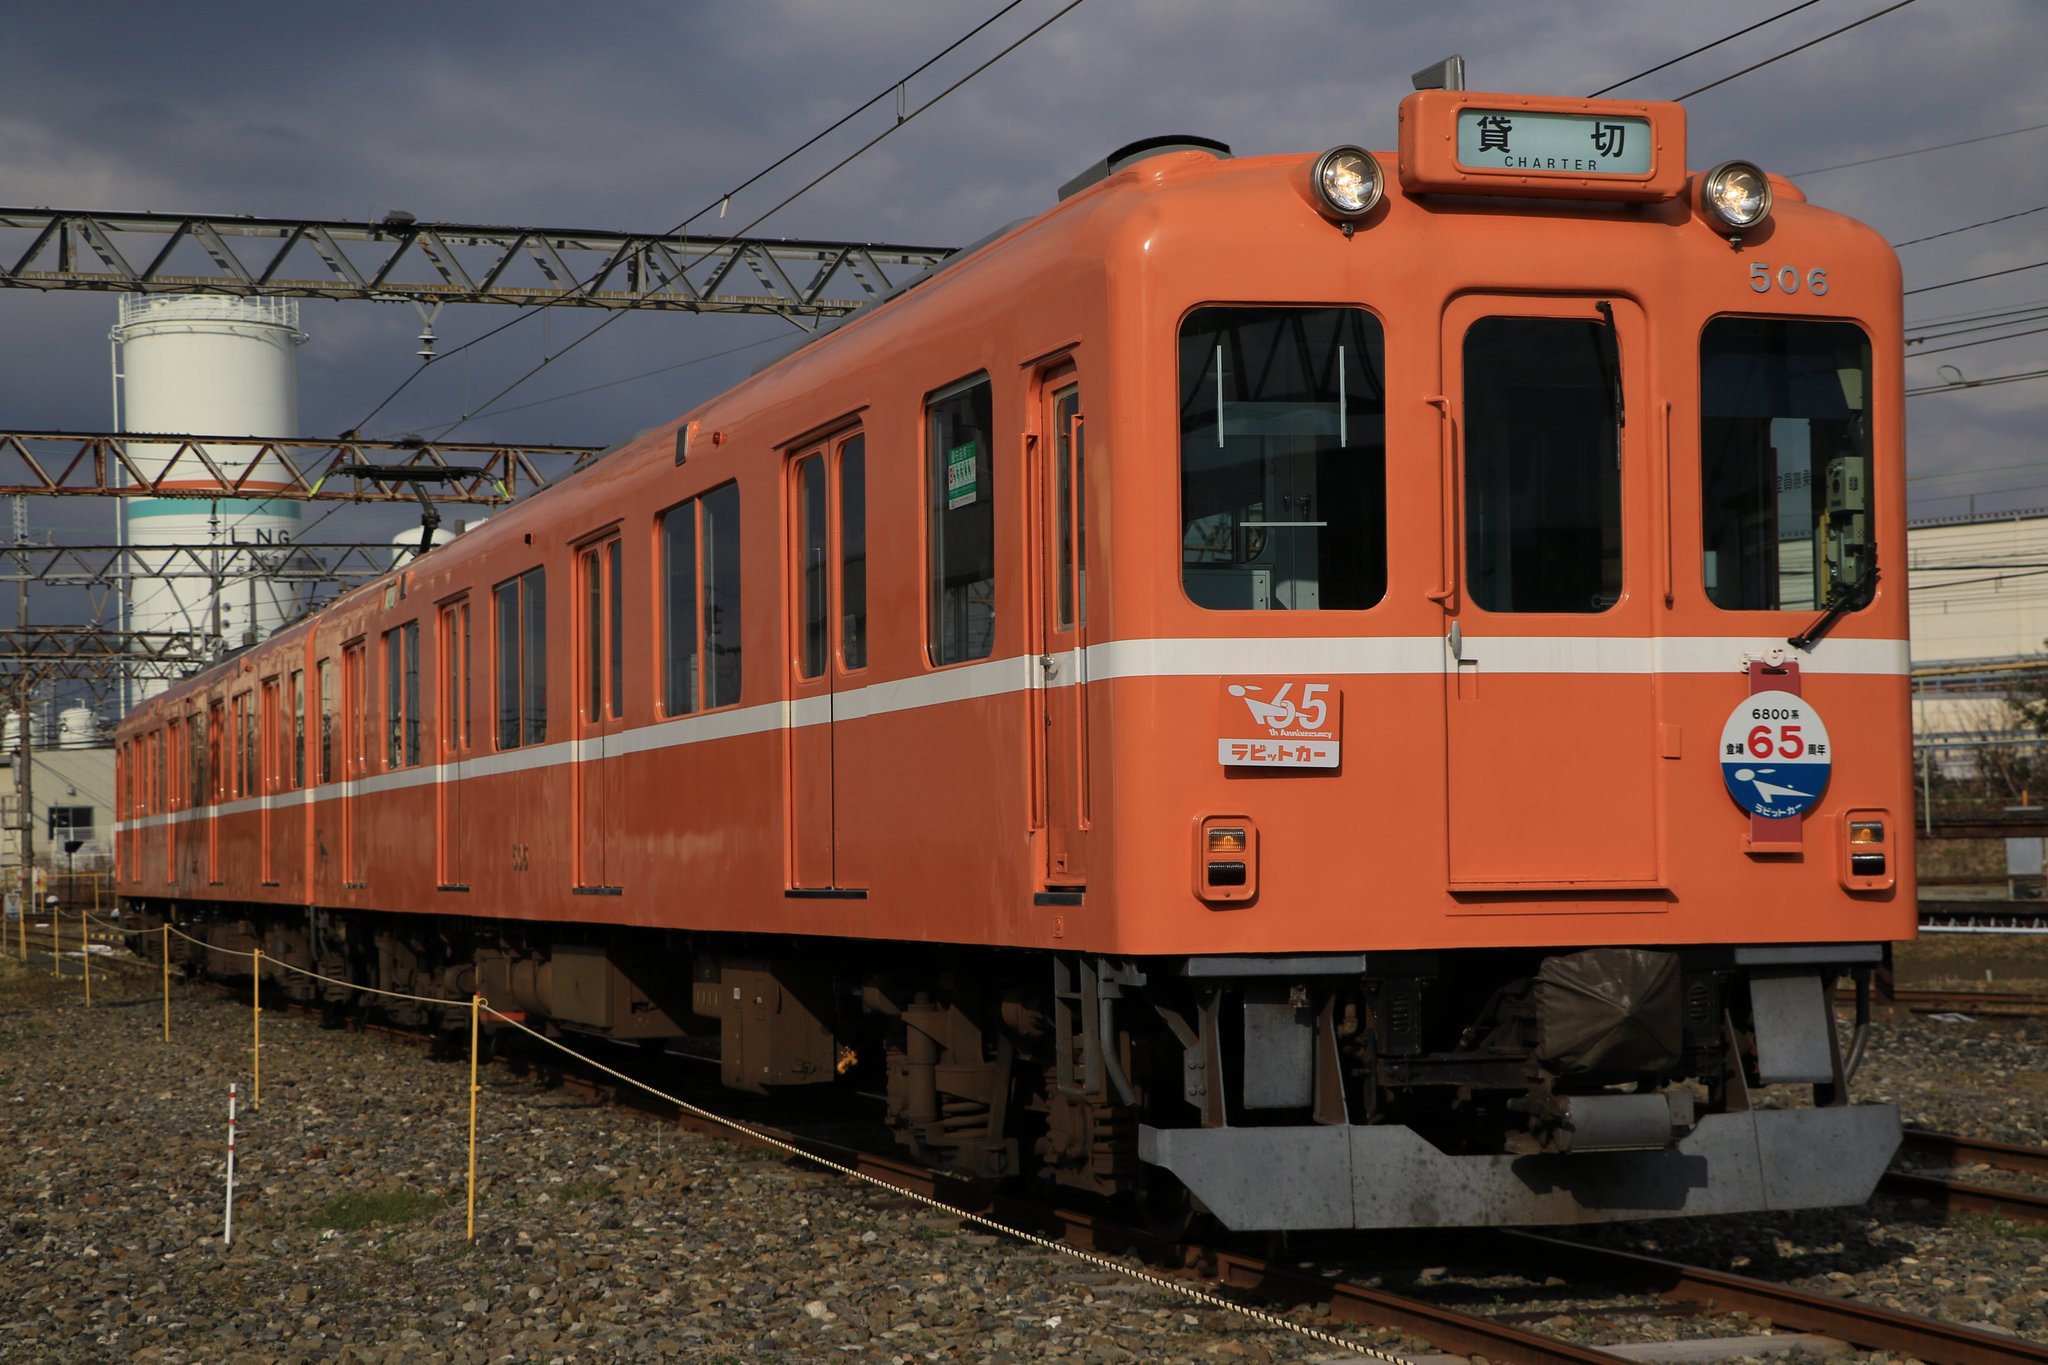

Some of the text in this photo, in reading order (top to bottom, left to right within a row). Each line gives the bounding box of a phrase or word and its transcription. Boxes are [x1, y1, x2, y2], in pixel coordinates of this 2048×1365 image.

[1476, 116, 1625, 158] 貸切
[1505, 156, 1597, 171] CHARTER
[1749, 262, 1828, 296] 506
[231, 527, 290, 546] LNG
[1266, 683, 1329, 729] 65
[1752, 709, 1799, 720] 6800系
[1280, 729, 1332, 739] Anniversary
[1748, 725, 1804, 759] 65
[1231, 744, 1326, 762] ラビットカー
[1755, 803, 1802, 817] ラビットカー
